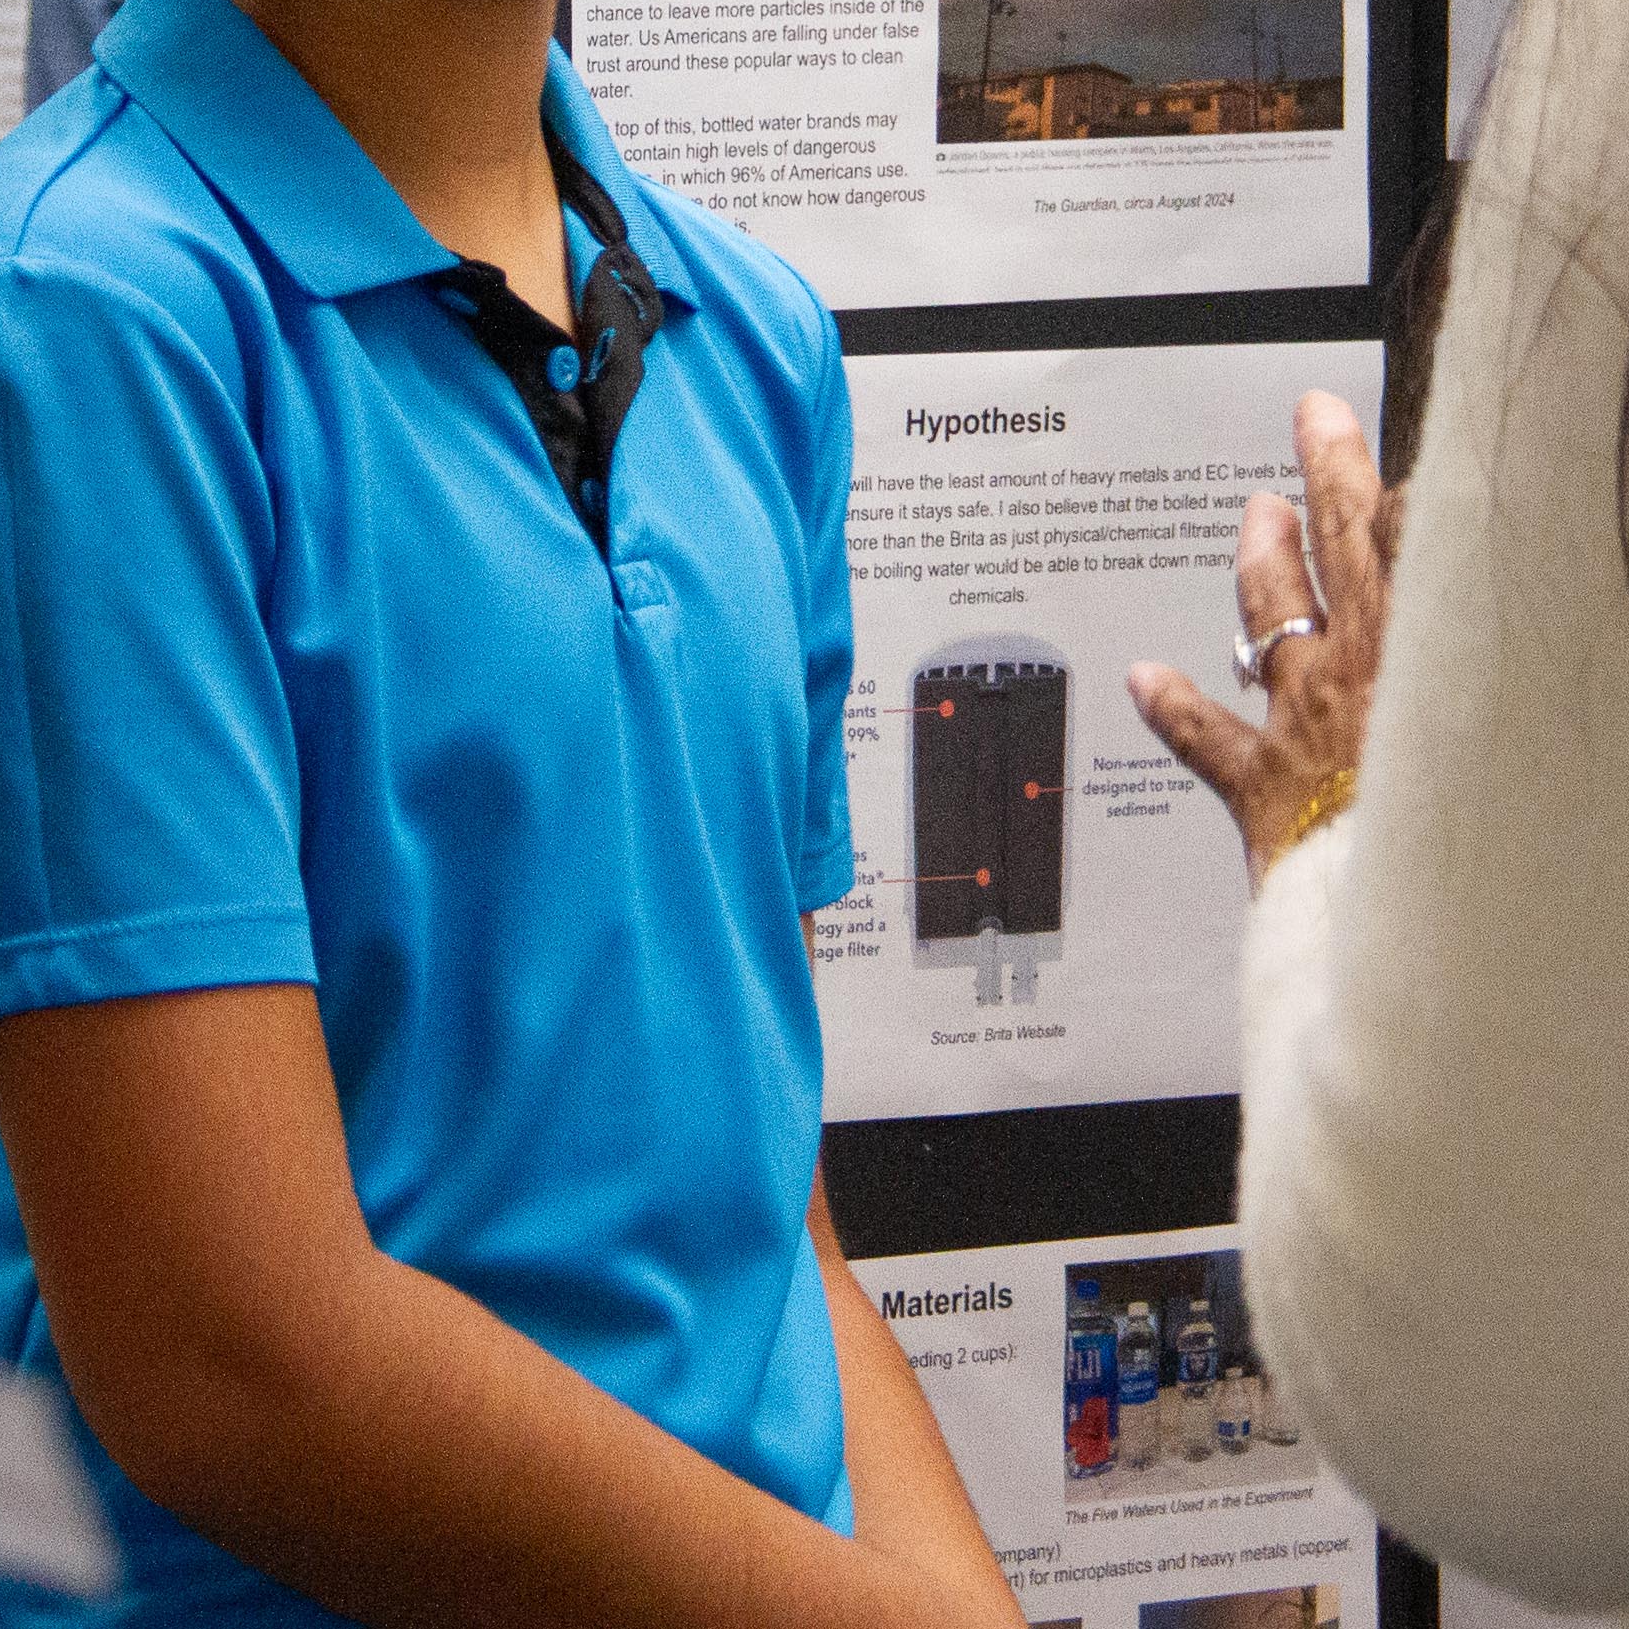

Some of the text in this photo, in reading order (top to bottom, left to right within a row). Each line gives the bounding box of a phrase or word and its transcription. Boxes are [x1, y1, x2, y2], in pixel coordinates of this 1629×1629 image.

[587, 4, 643, 22] chance
[648, 5, 663, 21] to
[668, 2, 710, 20] leave
[715, 4, 755, 18] more
[760, 0, 825, 20] particles
[587, 20, 919, 48] water. Us Americans are falling under false
[614, 111, 898, 140] top of this, bottled water brands may
[623, 136, 877, 166] contain high levels of dangerous
[1034, 192, 1235, 214] The Guardian, circa August 2024
[906, 405, 1066, 444] Hypothesis
[883, 533, 916, 550] than
[921, 532, 946, 549] the
[950, 528, 986, 548] Brita
[990, 533, 1008, 546] as
[1011, 528, 1040, 549] just
[1044, 523, 1177, 548] physical/chemical
[1180, 519, 1238, 540] filtration
[949, 586, 1029, 605] chemicals.
[857, 679, 875, 695] 60
[847, 727, 880, 742] 99%
[1082, 774, 1194, 799] designed to trap
[1107, 800, 1170, 818] sediment
[931, 1024, 1067, 1046] Source: Brita Website
[881, 1282, 1013, 1320] Materials
[957, 1348, 967, 1366] 2
[971, 1344, 1017, 1367] cups):
[1065, 1508, 1089, 1526] The
[1092, 1505, 1118, 1523] Five
[1170, 1497, 1205, 1515] Used
[1207, 1498, 1219, 1509] in
[1221, 1493, 1242, 1510] the
[1244, 1484, 1314, 1510] Experiment
[1029, 1569, 1050, 1587] for
[1054, 1557, 1152, 1585] microplastics
[1157, 1551, 1186, 1572] and
[1191, 1549, 1236, 1571] heavy
[1240, 1542, 1289, 1564] metals
